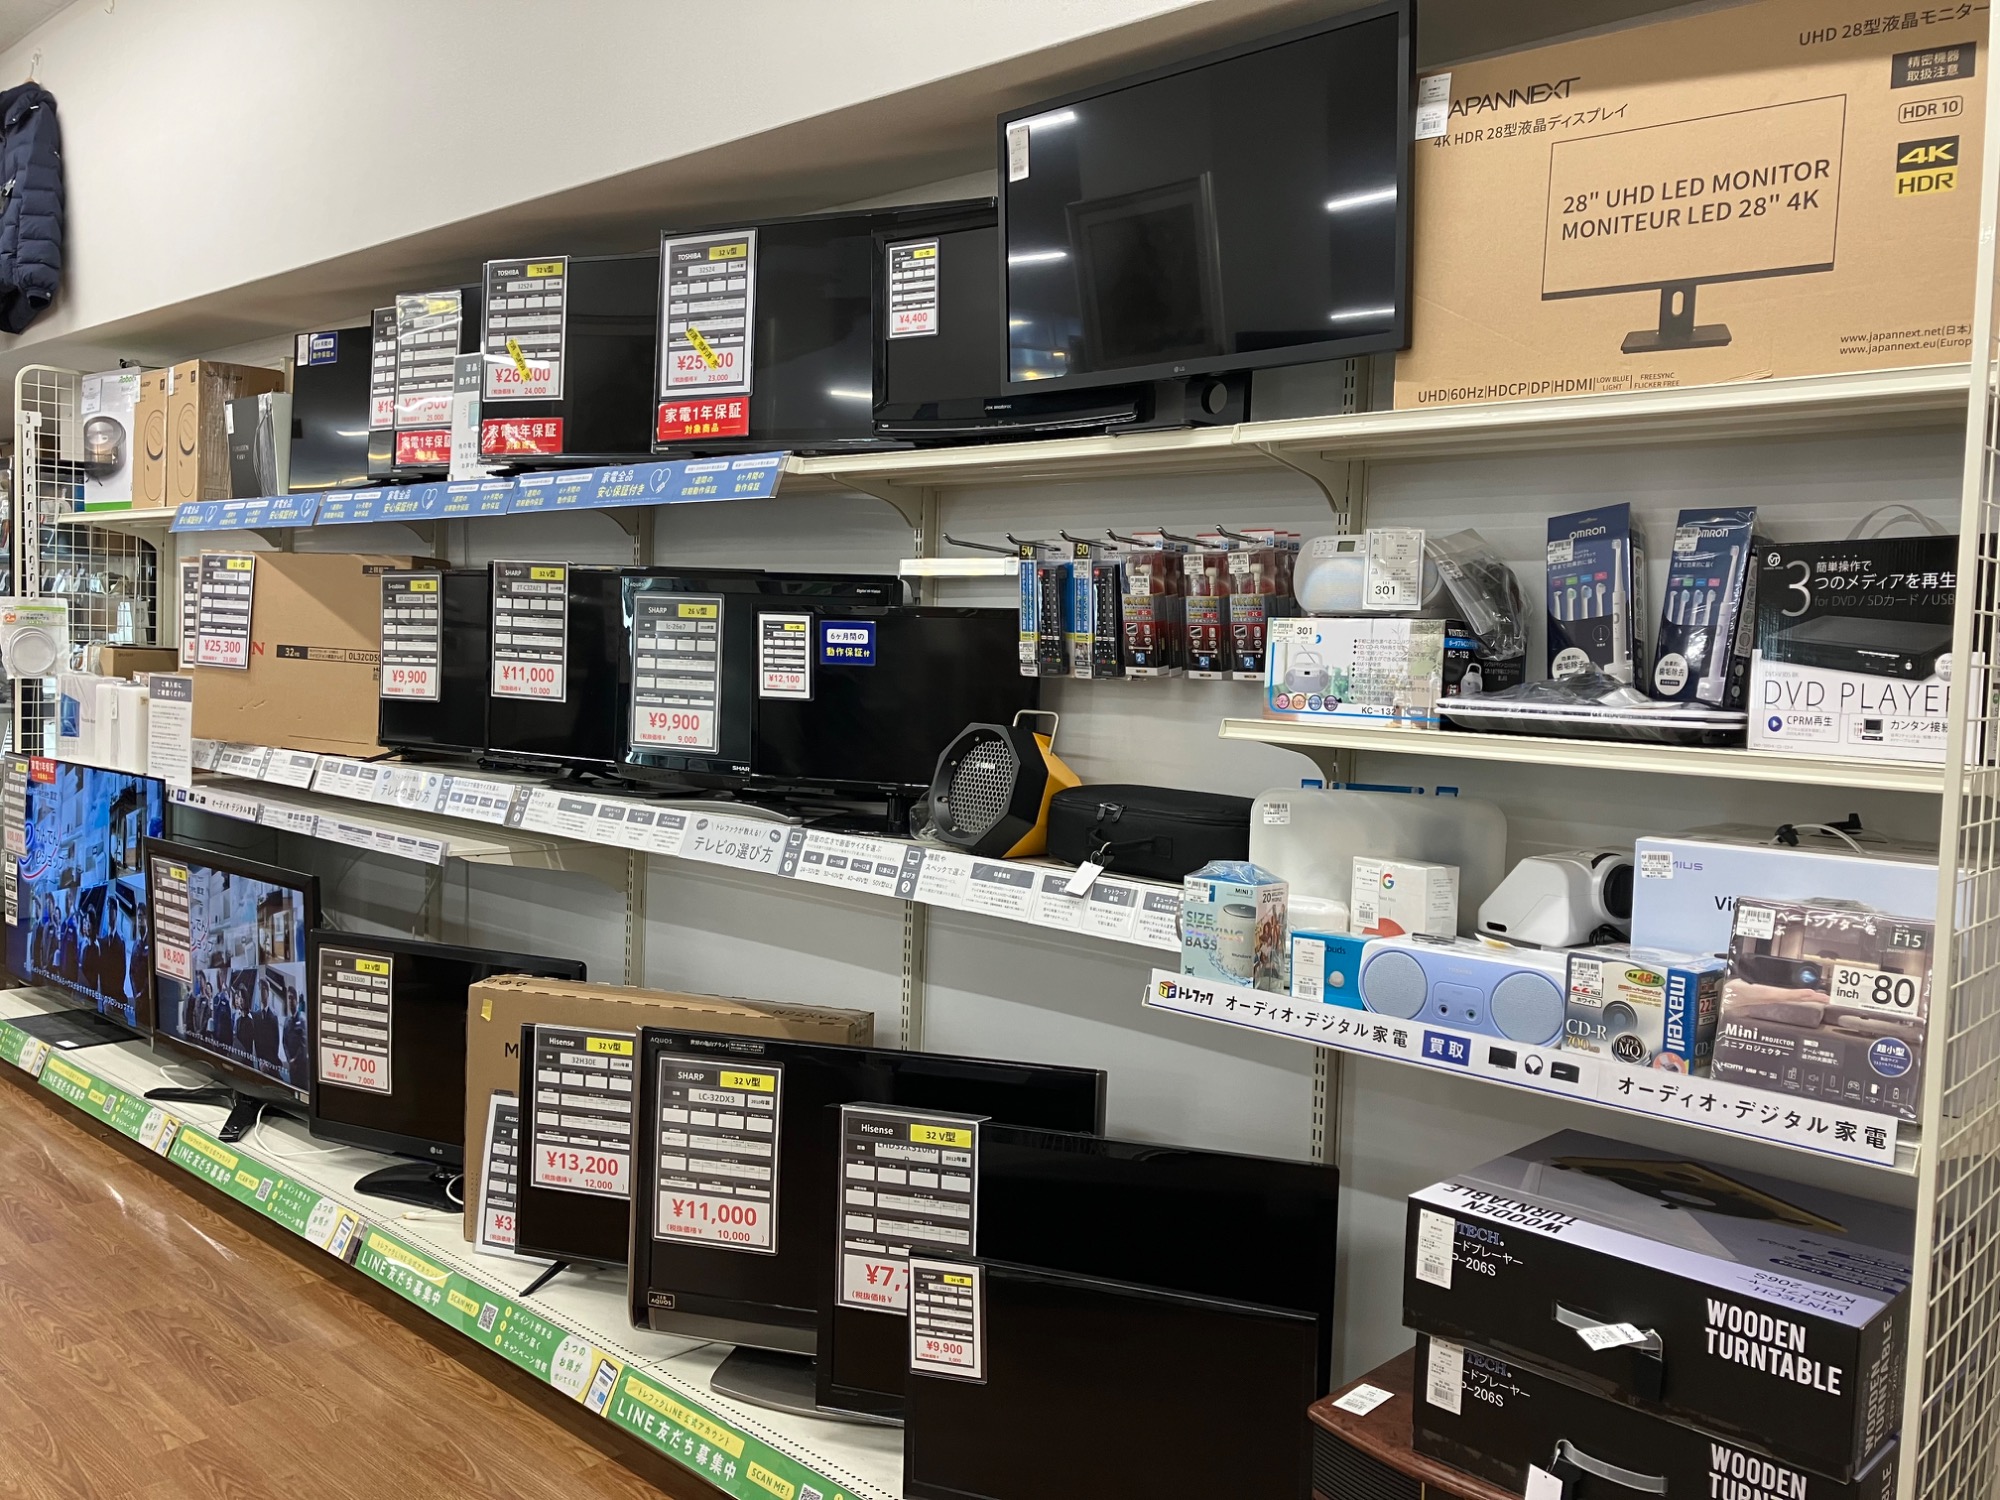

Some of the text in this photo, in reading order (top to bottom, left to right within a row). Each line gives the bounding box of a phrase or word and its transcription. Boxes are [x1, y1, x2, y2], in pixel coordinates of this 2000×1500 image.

[1799, 27, 1837, 46] UHD
[1907, 49, 1960, 68] 精密機器
[1906, 64, 1959, 82] 取扱注意
[1447, 76, 1581, 119] APANNEXT
[1903, 100, 1958, 119] HDR 10
[1433, 103, 1629, 149] 4K HDR 28型液晶ディスプレイ
[1899, 142, 1954, 164] 4K
[1562, 158, 1830, 214] 28" UHD LED MONITOR
[1898, 172, 1953, 194] HDR
[1561, 189, 1819, 241] MONITEUR LED 28" 4K
[677, 252, 701, 261] TOSHIBA
[497, 269, 519, 277] TOSHIBA
[899, 312, 928, 324] ¥4,400
[1840, 324, 1972, 343] www.japannext.net(日本)
[1839, 337, 1972, 355] www.japannext.eu(Europ
[665, 402, 742, 423] 家電1年保証
[684, 423, 719, 435] 対象商品
[601, 469, 634, 484] 家電全品
[596, 483, 645, 498] 安心保証付き
[734, 481, 761, 492] 動作保証
[1568, 526, 1607, 540] OMRON
[504, 569, 522, 577] SHARP
[1816, 560, 1872, 573] 簡単操作で
[1781, 560, 1812, 617] 3
[1814, 572, 1956, 590] つのメディアを再生
[1374, 585, 1396, 595] 301
[1814, 593, 1955, 606] for DVD SDカード USB
[647, 606, 668, 615] SHARP
[687, 607, 695, 615] 26
[830, 632, 865, 641] 6ヶ月間の
[1296, 626, 1313, 635] 301
[204, 639, 241, 654] ¥25,300
[1447, 650, 1470, 660] KC-132
[1556, 660, 1586, 671] 歯垢除去
[1658, 667, 1685, 677] 歯垢除去
[392, 669, 427, 685] ¥9,900
[502, 665, 555, 683] ¥11,000
[768, 673, 800, 684] ¥12,100
[1764, 680, 1951, 713] DVD PLAYE
[648, 711, 700, 731] ¥9,900
[1786, 715, 1833, 728] CPRM再生
[677, 735, 697, 744] 9,000
[694, 836, 774, 864] テレビの選び方
[1235, 887, 1249, 896] MINI
[1262, 893, 1272, 903] 20
[1185, 937, 1217, 951] BASS
[1893, 932, 1922, 948] F15
[163, 947, 186, 965] ¥8,800
[1637, 972, 1652, 984] 48
[1836, 986, 1859, 1000] inch
[1666, 975, 1686, 1052] maxell
[1178, 986, 1465, 1060] トレファク オーディオ・デジタル家電 買取
[1566, 1019, 1607, 1040] CD-R
[1725, 1023, 1758, 1040] Mini
[549, 1037, 575, 1047] Hisense
[598, 1041, 621, 1052] 32 V型
[650, 1036, 673, 1044] AQUOS
[1723, 1040, 1790, 1056] ミニプロジェクター
[1761, 1036, 1795, 1047] PROJECTOR
[1618, 1041, 1641, 1060] MQ
[1876, 1043, 1906, 1057] 超小型
[332, 1053, 376, 1074] ¥7,700
[571, 1056, 596, 1066] 32H30E
[358, 1076, 375, 1086] 7,000
[677, 1071, 705, 1081] SHARP
[734, 1077, 760, 1087] 32 V型
[698, 1092, 735, 1103] LC-32DX3
[1617, 1076, 1888, 1150] オーディオ・デジタル家電
[860, 1123, 894, 1136] Hisense
[926, 1131, 956, 1143] 32 V型
[546, 1151, 619, 1176] ¥13,200
[584, 1179, 613, 1190] 12,000
[672, 1197, 757, 1227] ¥11,000
[1443, 1183, 1580, 1226] TURNTABLE
[1460, 1200, 1566, 1234] WOODEN
[717, 1228, 750, 1242] 10,000
[1453, 1240, 1524, 1265] ードプレーヤー
[513, 1310, 552, 1340] ポイント貯まる
[1706, 1297, 1806, 1354] WOODEN
[926, 1339, 963, 1355] ¥9,900
[503, 1339, 548, 1374] キャンペーン情報
[1704, 1327, 1843, 1396] TURNTABLE
[1462, 1368, 1531, 1398] ードプレーヤー
[1873, 1315, 1893, 1448] TURNTABLE
[1864, 1360, 1881, 1458] WOODEN
[751, 1467, 773, 1486] SCAN
[1710, 1442, 1807, 1500] WOODEN
